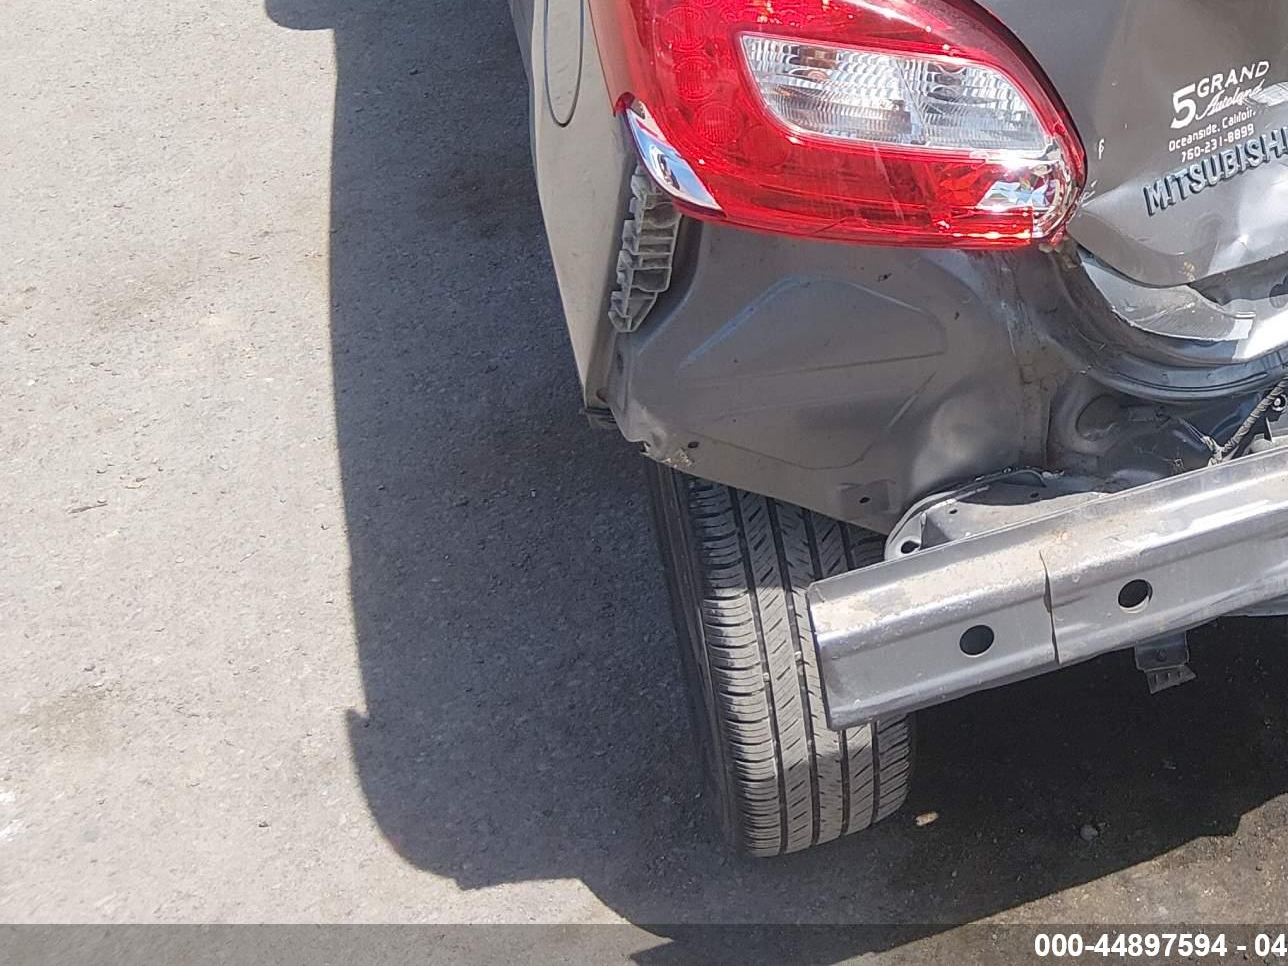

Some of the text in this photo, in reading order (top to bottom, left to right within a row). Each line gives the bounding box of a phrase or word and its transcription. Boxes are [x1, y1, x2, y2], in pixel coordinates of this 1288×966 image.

[1170, 61, 1270, 129] 5 GRAND
[1181, 123, 1255, 163] 760-231-8899
